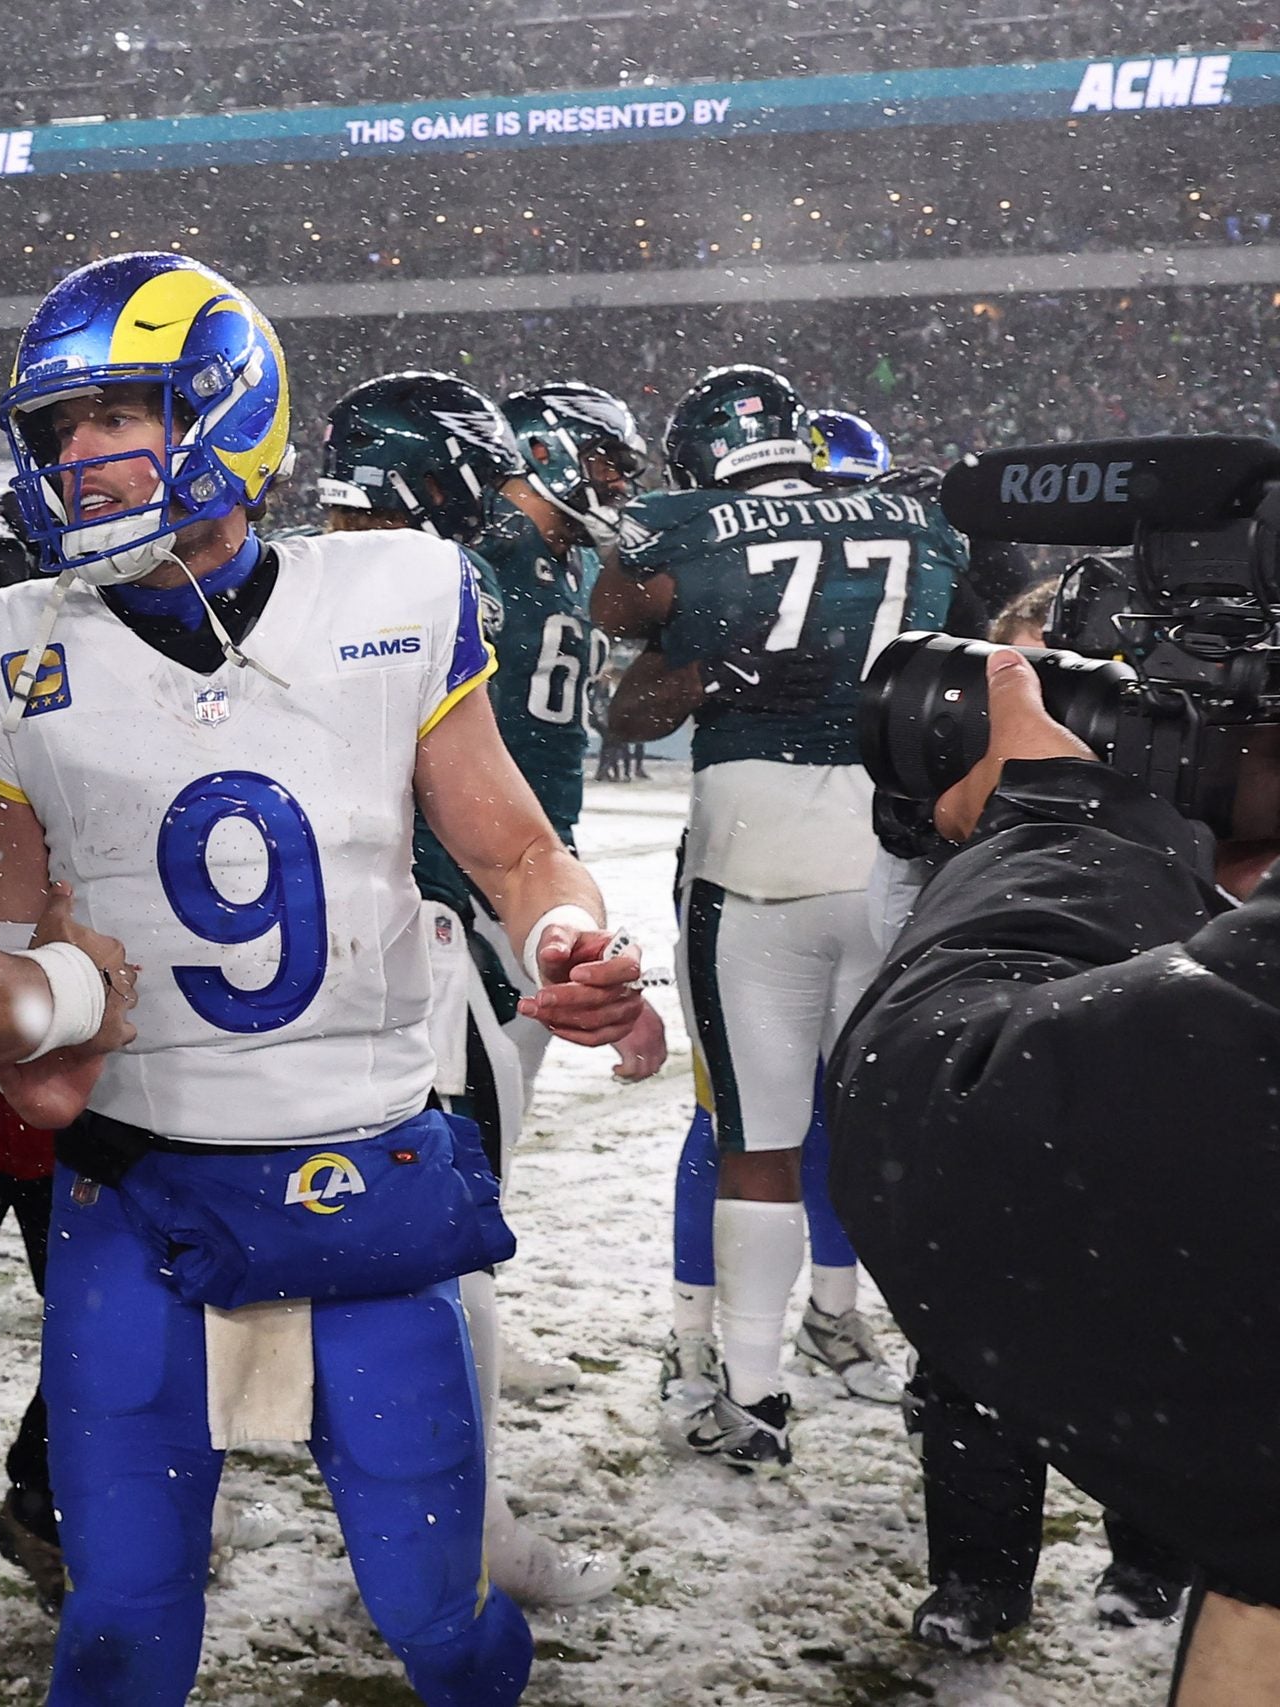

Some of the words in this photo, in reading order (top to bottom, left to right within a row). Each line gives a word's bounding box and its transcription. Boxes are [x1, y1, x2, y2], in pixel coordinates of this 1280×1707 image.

[1071, 55, 1231, 113] ACME
[346, 119, 405, 145] THIS
[411, 113, 489, 141] GAME
[495, 111, 521, 136] IS
[528, 101, 686, 134] PRESENTED
[693, 97, 731, 124] BY
[1000, 462, 1133, 503] RØDE
[708, 494, 874, 542] BECTON
[746, 540, 911, 682] 77
[339, 637, 421, 661] RAMS
[201, 702, 224, 719] NFL
[944, 689, 961, 701] G
[157, 770, 328, 1033] 9
[284, 1152, 366, 1214] LA
